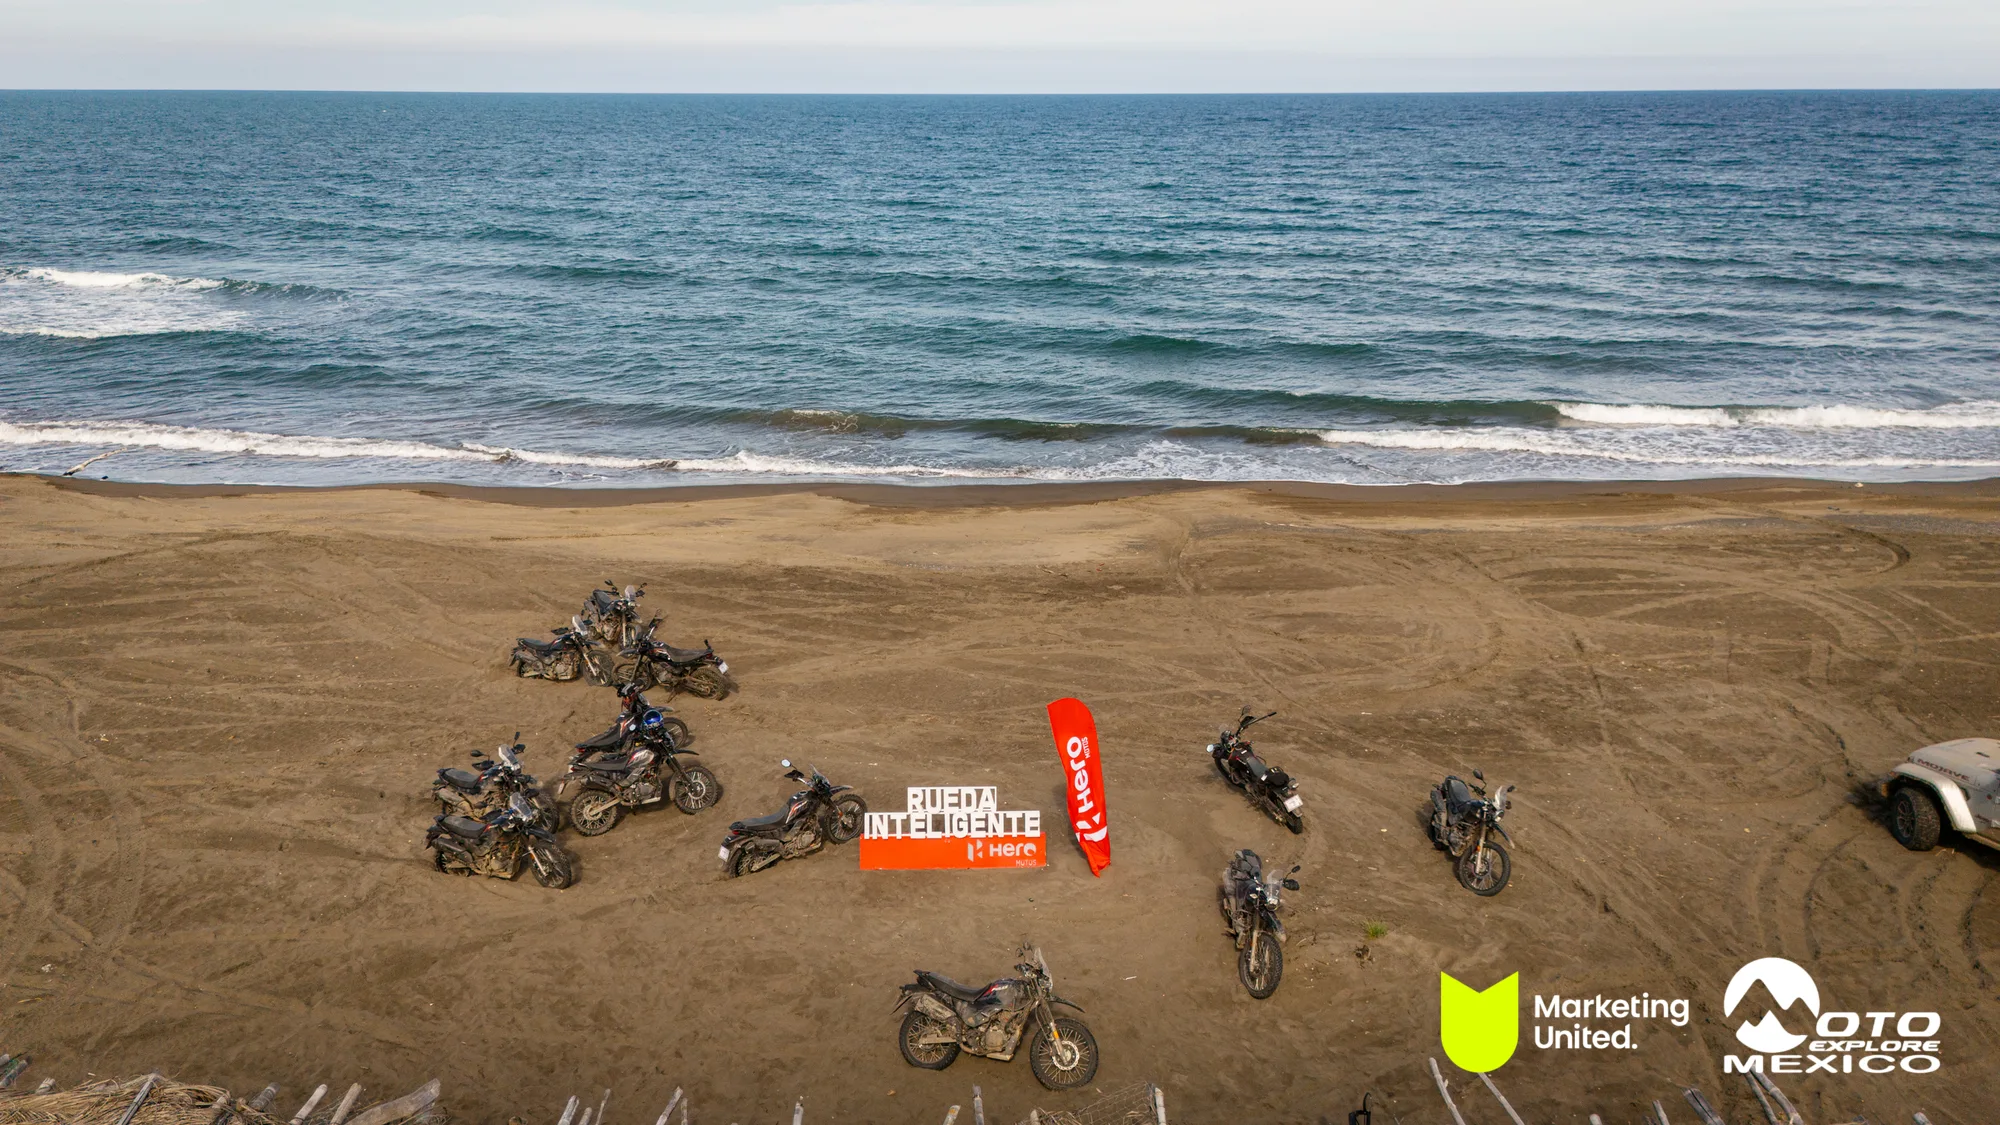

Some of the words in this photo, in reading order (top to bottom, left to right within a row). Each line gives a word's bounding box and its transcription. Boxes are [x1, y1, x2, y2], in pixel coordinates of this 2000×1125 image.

[1067, 736, 1094, 814] Hero
[1917, 758, 1970, 781] MOJAVE
[907, 786, 996, 814] RUEDA
[864, 811, 1040, 839] INTELIGENTE
[989, 842, 1037, 857] Hero
